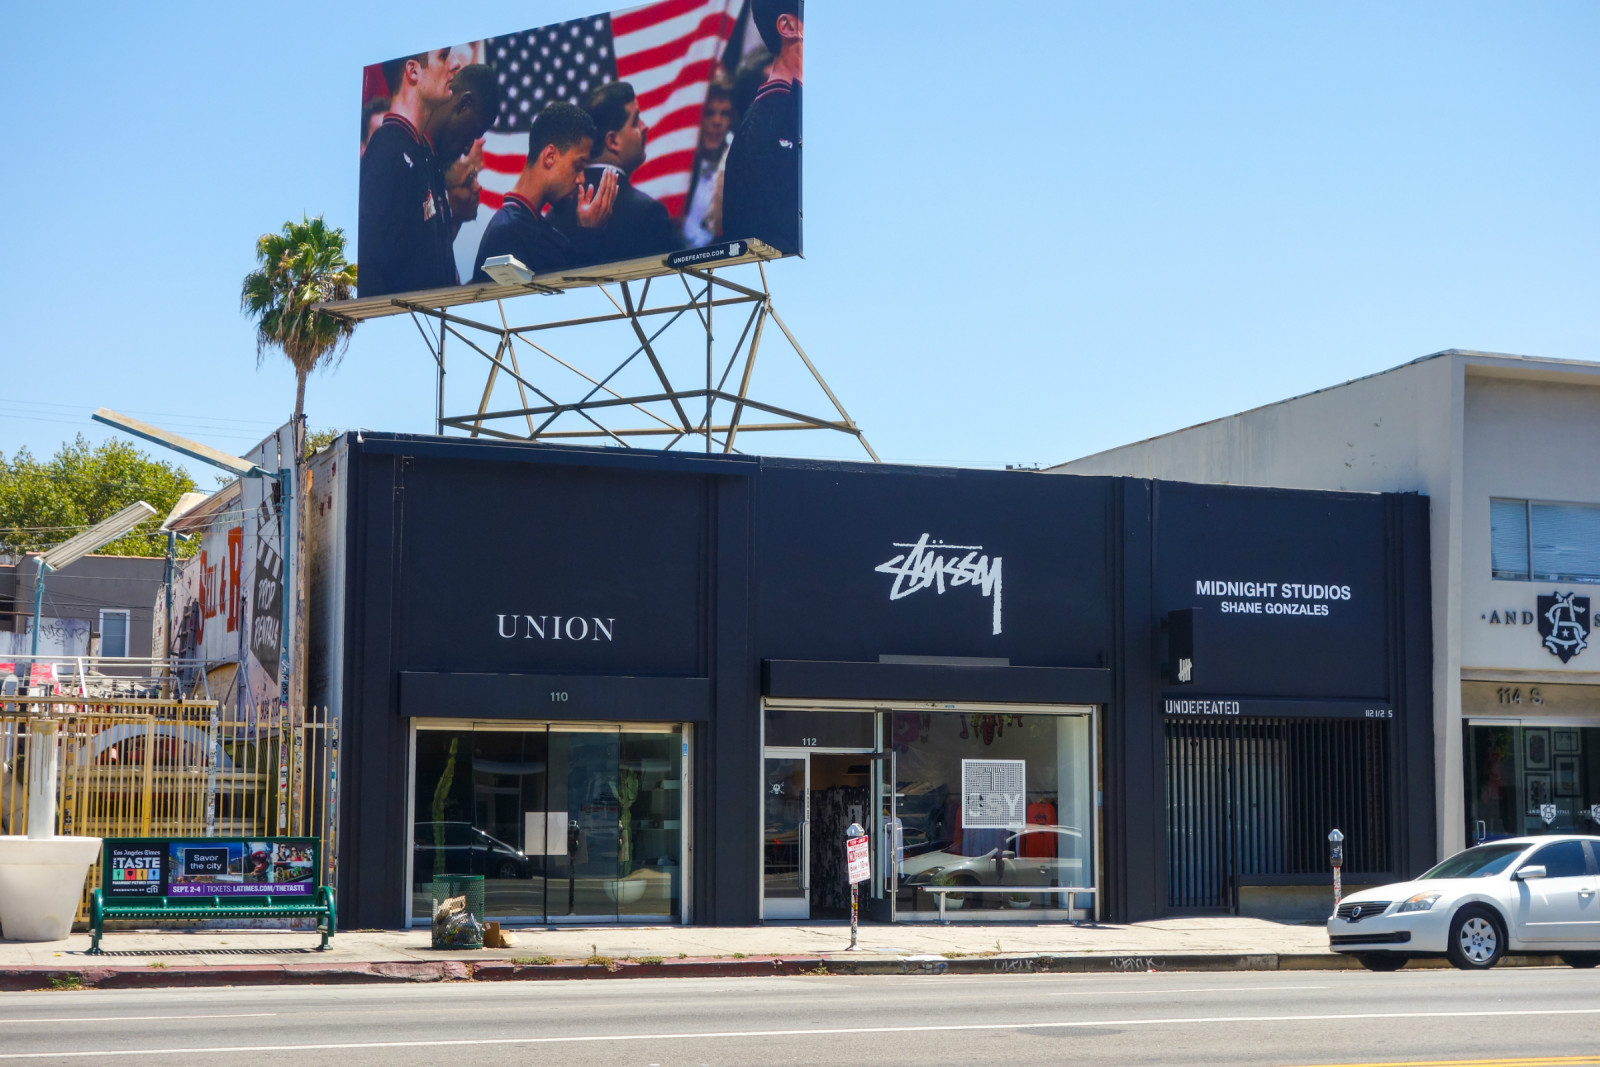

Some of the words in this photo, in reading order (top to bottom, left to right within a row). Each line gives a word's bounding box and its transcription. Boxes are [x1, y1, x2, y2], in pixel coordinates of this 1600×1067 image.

[673, 249, 725, 264] UNDEFEATED.COM
[219, 556, 227, 615] &
[1196, 580, 1278, 598] MIDNIGHT
[1281, 583, 1352, 600] STUDIOS
[257, 578, 276, 610] PROP
[1221, 601, 1263, 614] SHANE
[1265, 602, 1329, 616] GONZALES
[253, 616, 280, 650] RENTALS
[496, 614, 616, 641] UNION
[550, 691, 569, 702] 110
[1496, 687, 1522, 704] 114
[1165, 700, 1240, 715] UNDEFEATED
[1365, 709, 1374, 718] 112
[1375, 709, 1385, 718] 1/2
[1388, 709, 1393, 718] S
[802, 737, 817, 746] 112
[117, 857, 160, 869] TASTE
[206, 862, 222, 870] city
[146, 885, 158, 893] citi
[207, 885, 232, 893] TICKETS:
